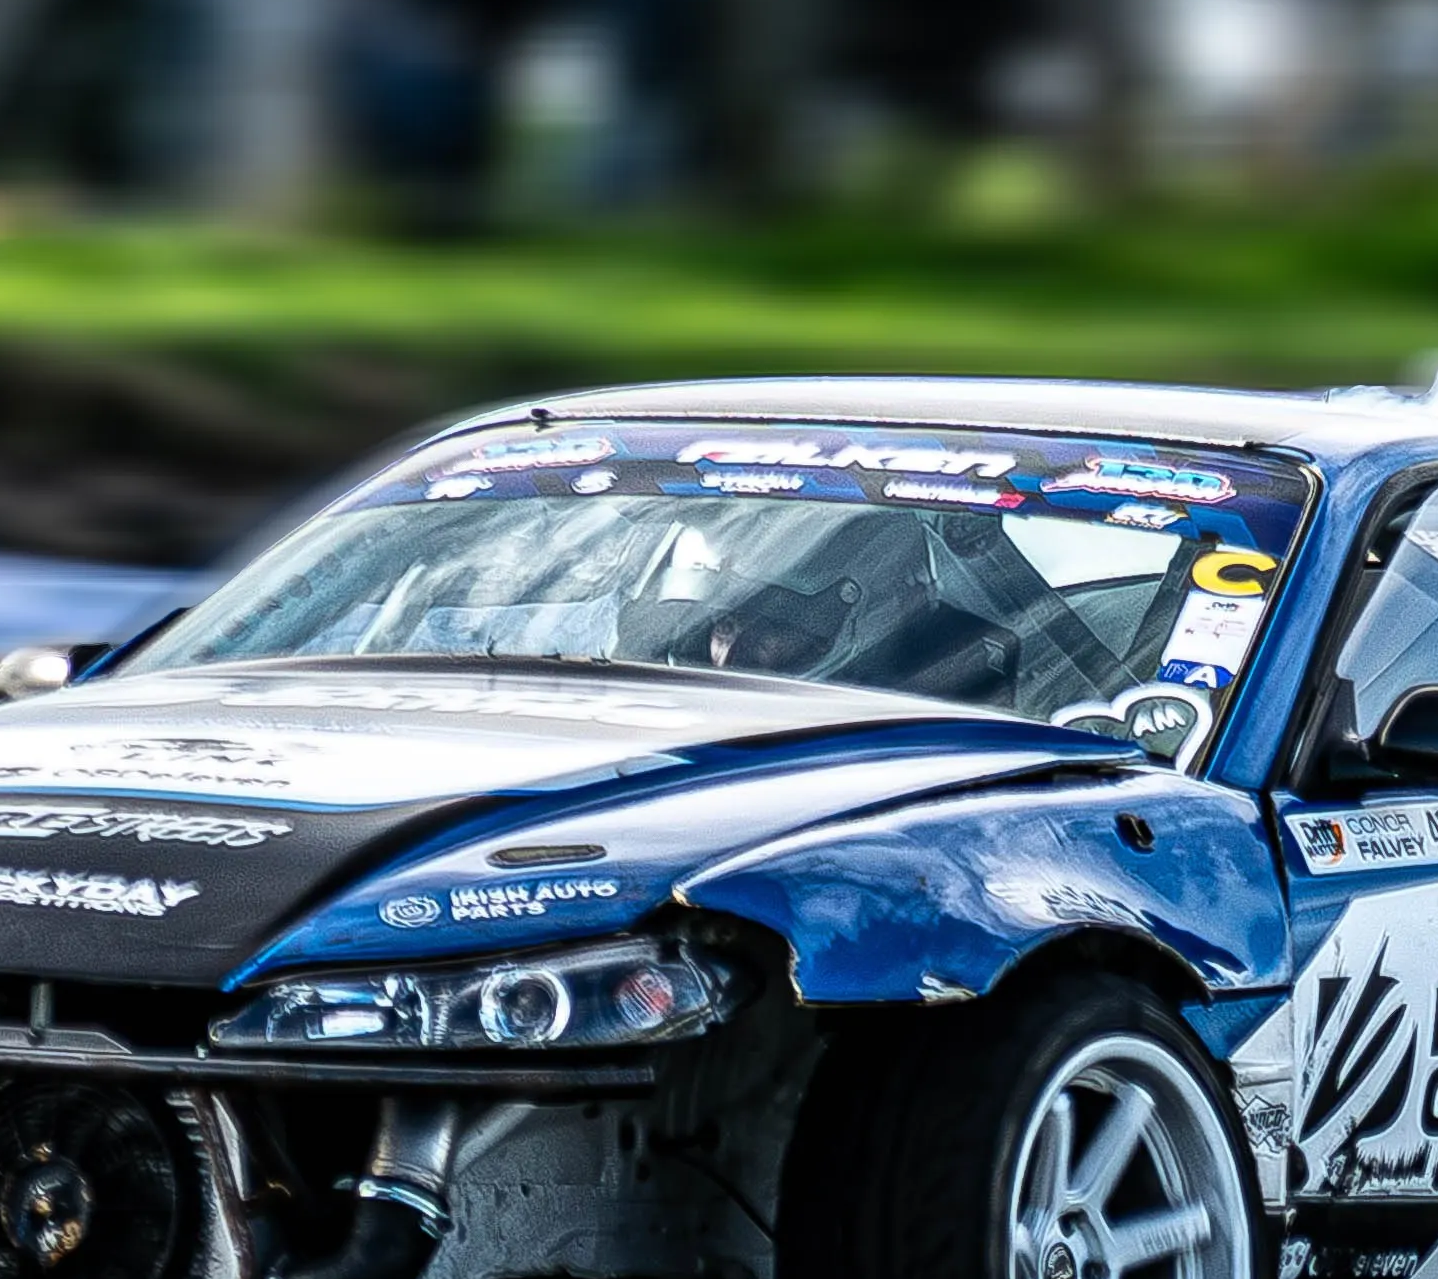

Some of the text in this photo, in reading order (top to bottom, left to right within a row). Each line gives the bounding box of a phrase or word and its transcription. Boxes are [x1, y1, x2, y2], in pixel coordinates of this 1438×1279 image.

[1346, 814, 1414, 835] CONOR
[1357, 835, 1425, 860] FALVEY
[450, 878, 619, 908] IRISH AUTO
[451, 901, 546, 922] PARTS
